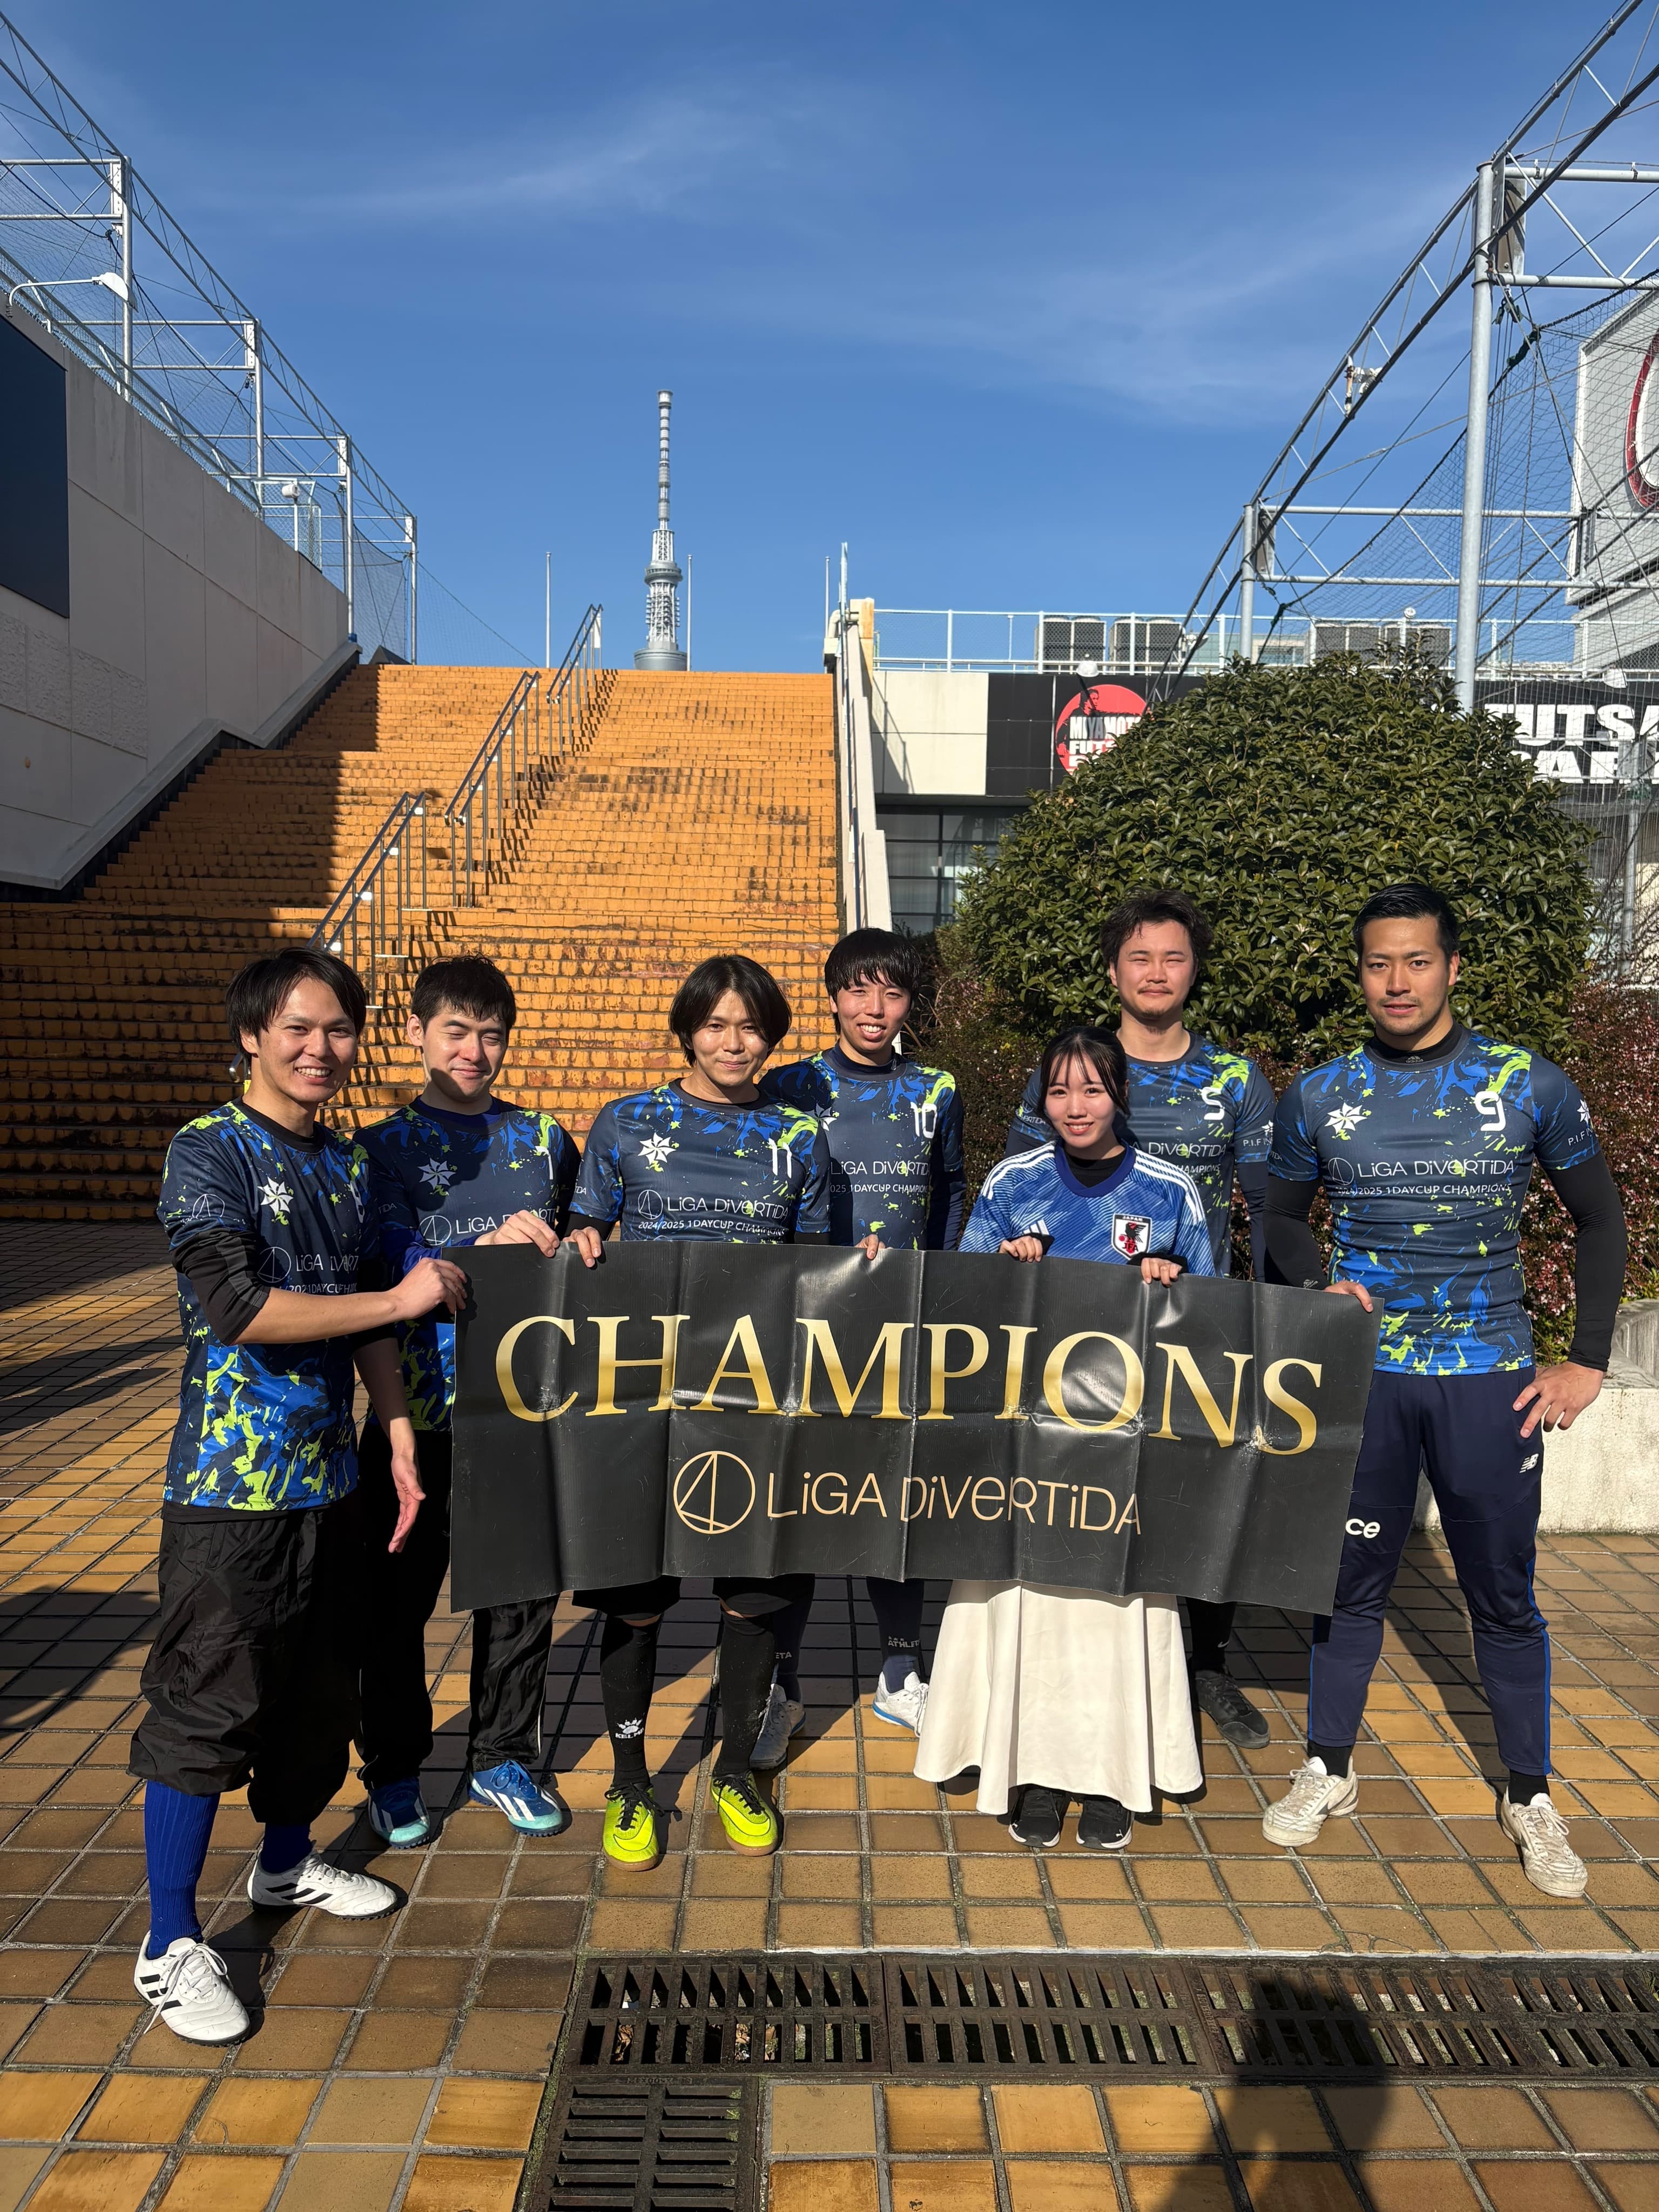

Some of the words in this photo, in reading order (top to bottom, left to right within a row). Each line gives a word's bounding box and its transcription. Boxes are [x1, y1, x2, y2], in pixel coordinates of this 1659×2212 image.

[1475, 1091, 1506, 1131] 9
[911, 1101, 938, 1139] 10
[768, 1137, 792, 1179] 11
[1177, 1164, 1221, 1174] HAMPIONS
[851, 1184, 891, 1192] 1DAYCUP
[1387, 1185, 1440, 1195] 1DAYCUP
[1447, 1184, 1513, 1195] CHAMPIONS
[638, 1219, 685, 1230] 2024/2025
[687, 1219, 734, 1229] 1DAYCUP
[1122, 1243, 1139, 1252] JFA
[495, 1314, 1322, 1455] CHAMPIONS
